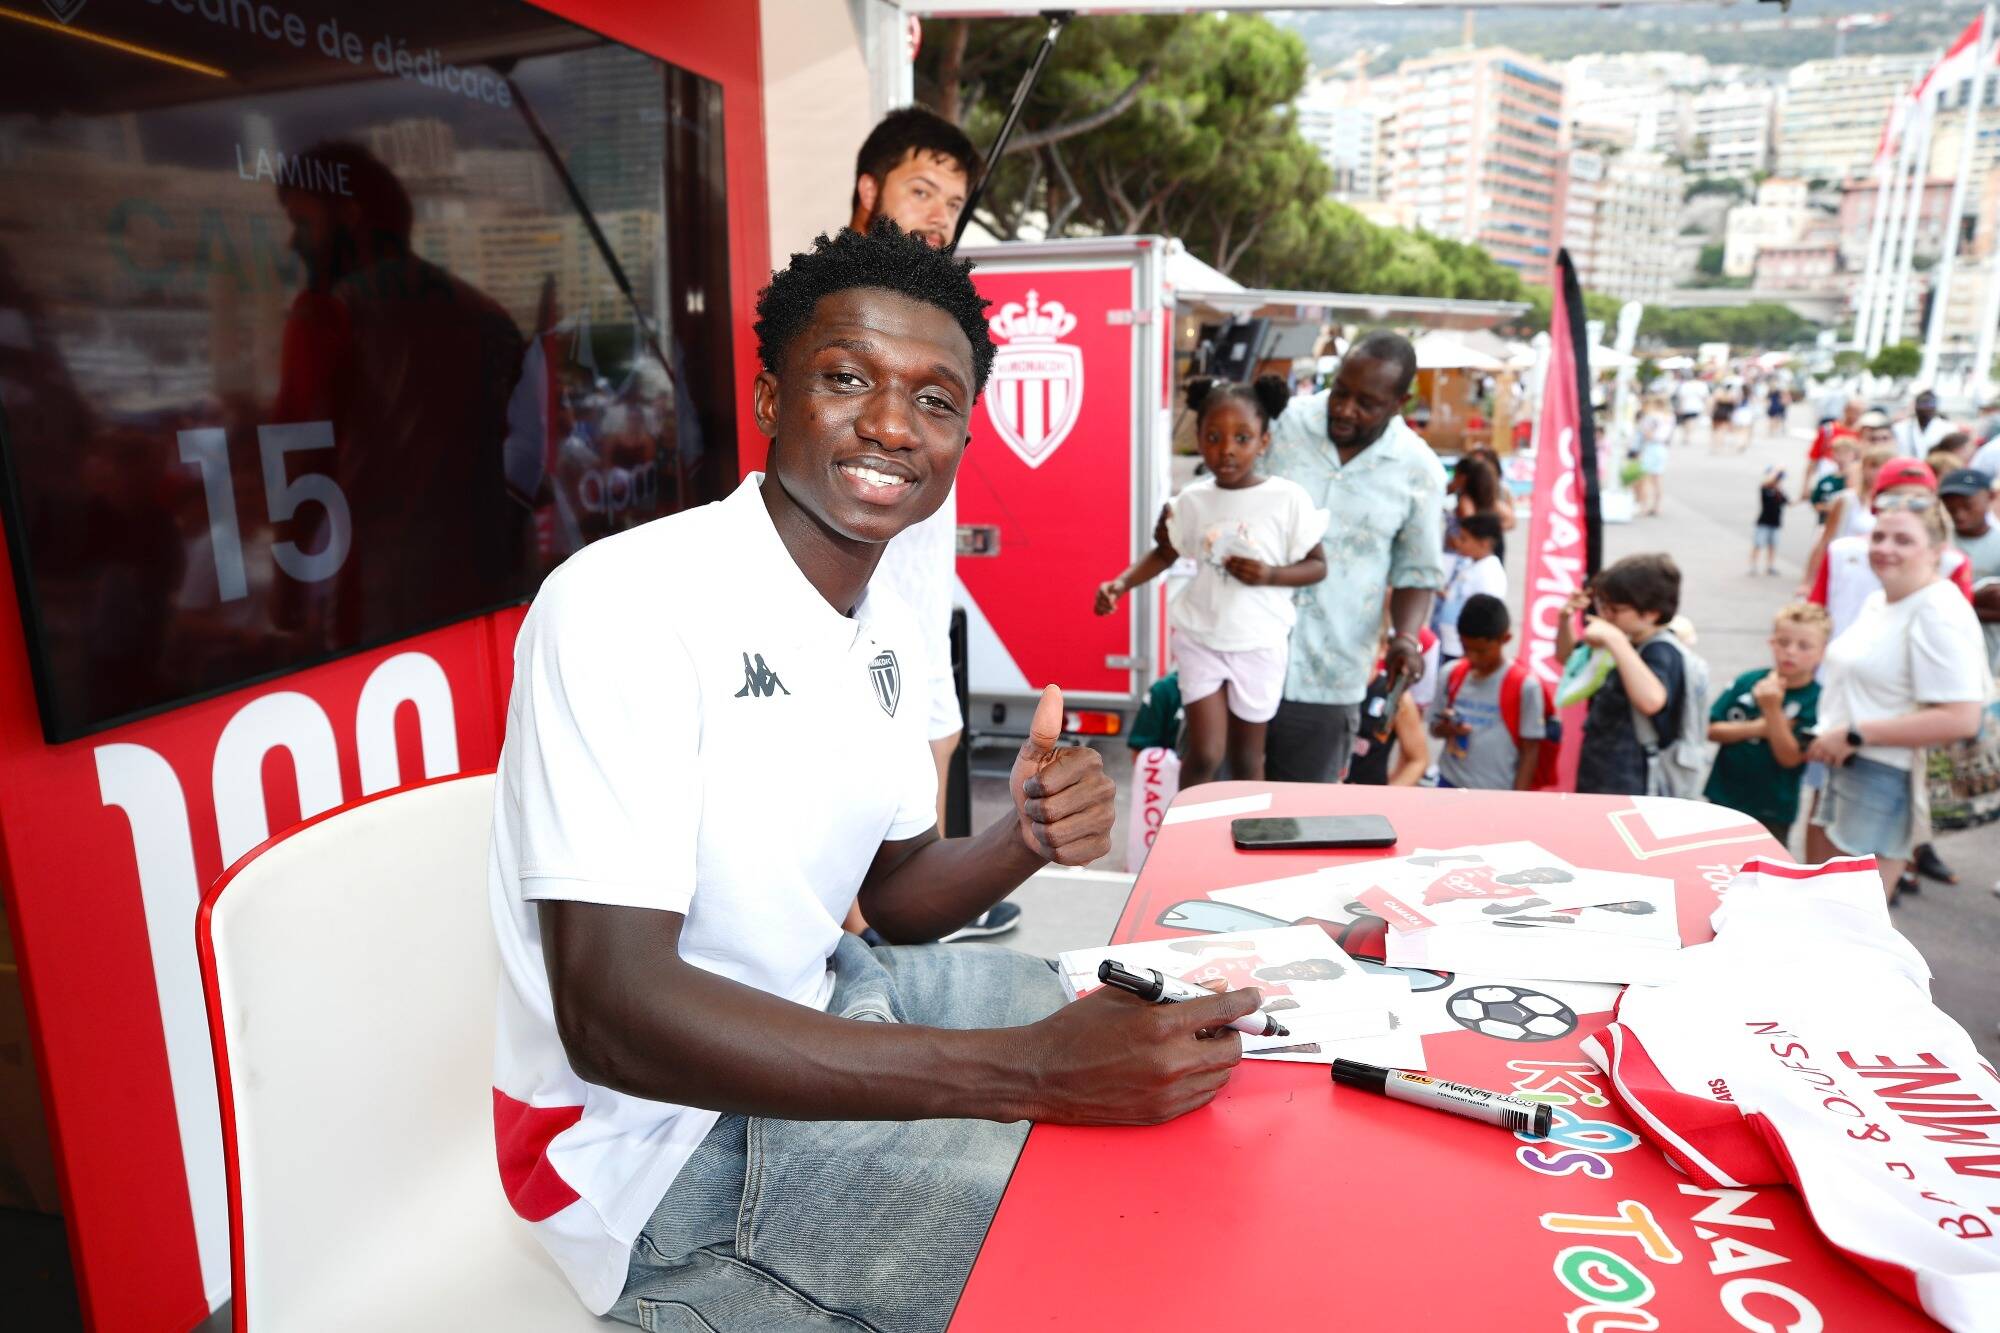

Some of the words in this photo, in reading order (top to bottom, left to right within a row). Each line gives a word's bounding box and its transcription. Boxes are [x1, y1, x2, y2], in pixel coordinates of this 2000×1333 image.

[319, 18, 364, 65] de
[373, 33, 512, 110] dédicace
[236, 143, 354, 197] LAMINE
[177, 420, 353, 602] 15
[1438, 1081, 1493, 1102] Marking
[1438, 1092, 1468, 1103] PERMANENT
[1468, 1099, 1490, 1108] MARKER
[1847, 1123, 1891, 1144] &
